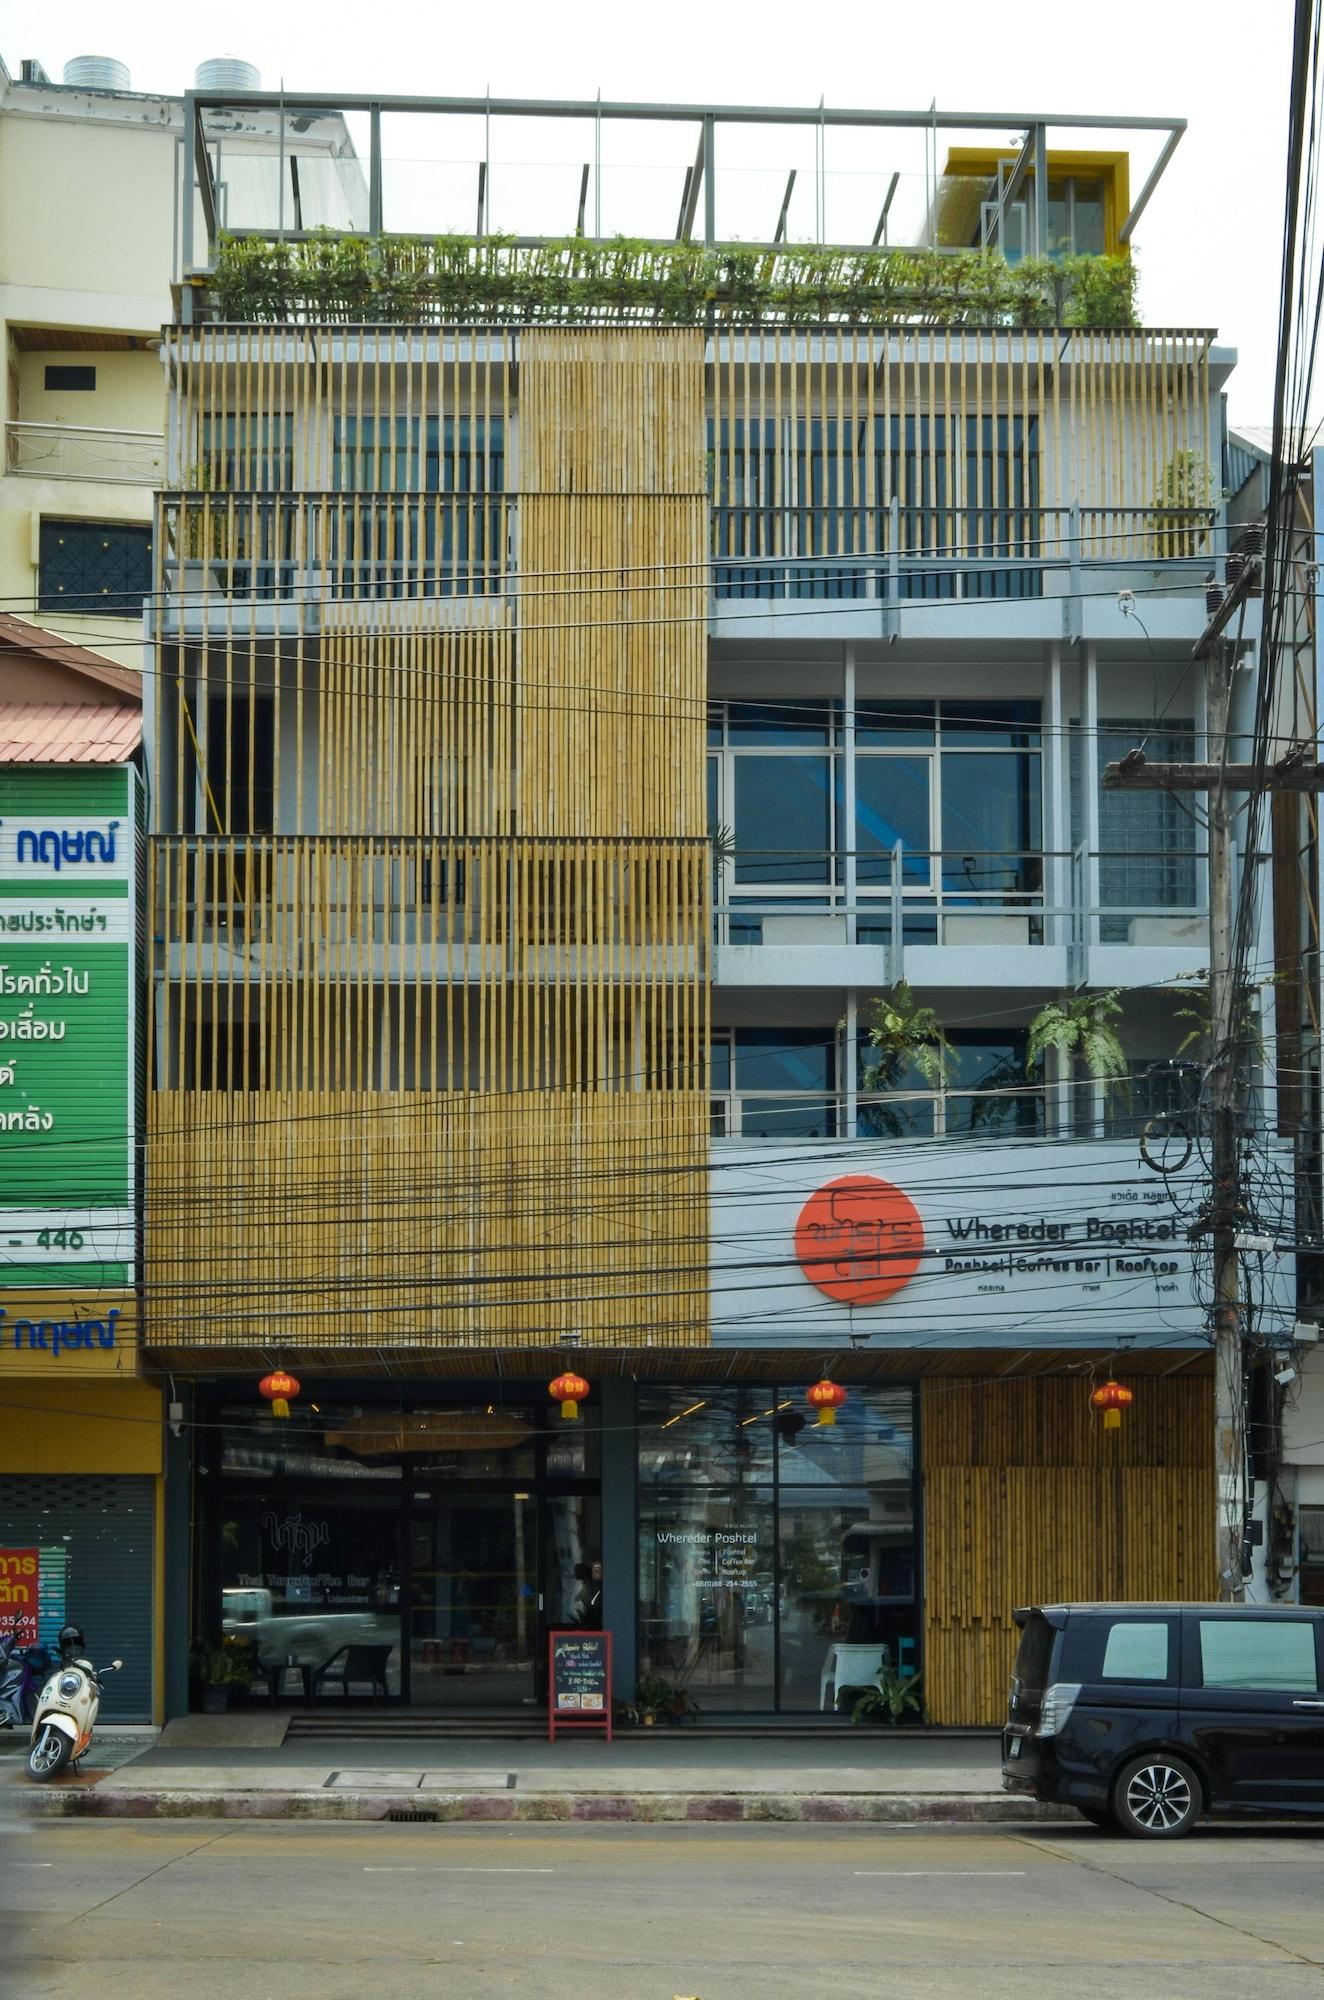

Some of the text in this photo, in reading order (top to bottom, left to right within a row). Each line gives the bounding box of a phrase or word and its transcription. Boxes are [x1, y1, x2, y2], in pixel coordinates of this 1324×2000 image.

[17, 820, 120, 871] กฤษณ์
[946, 1217, 1071, 1240] Whereder
[1116, 1257, 1179, 1273] Rooftop
[15, 1309, 120, 1357] กฤษณ์
[656, 1532, 758, 1544] Whereder Poshtel
[0, 1615, 37, 1626] 35294
